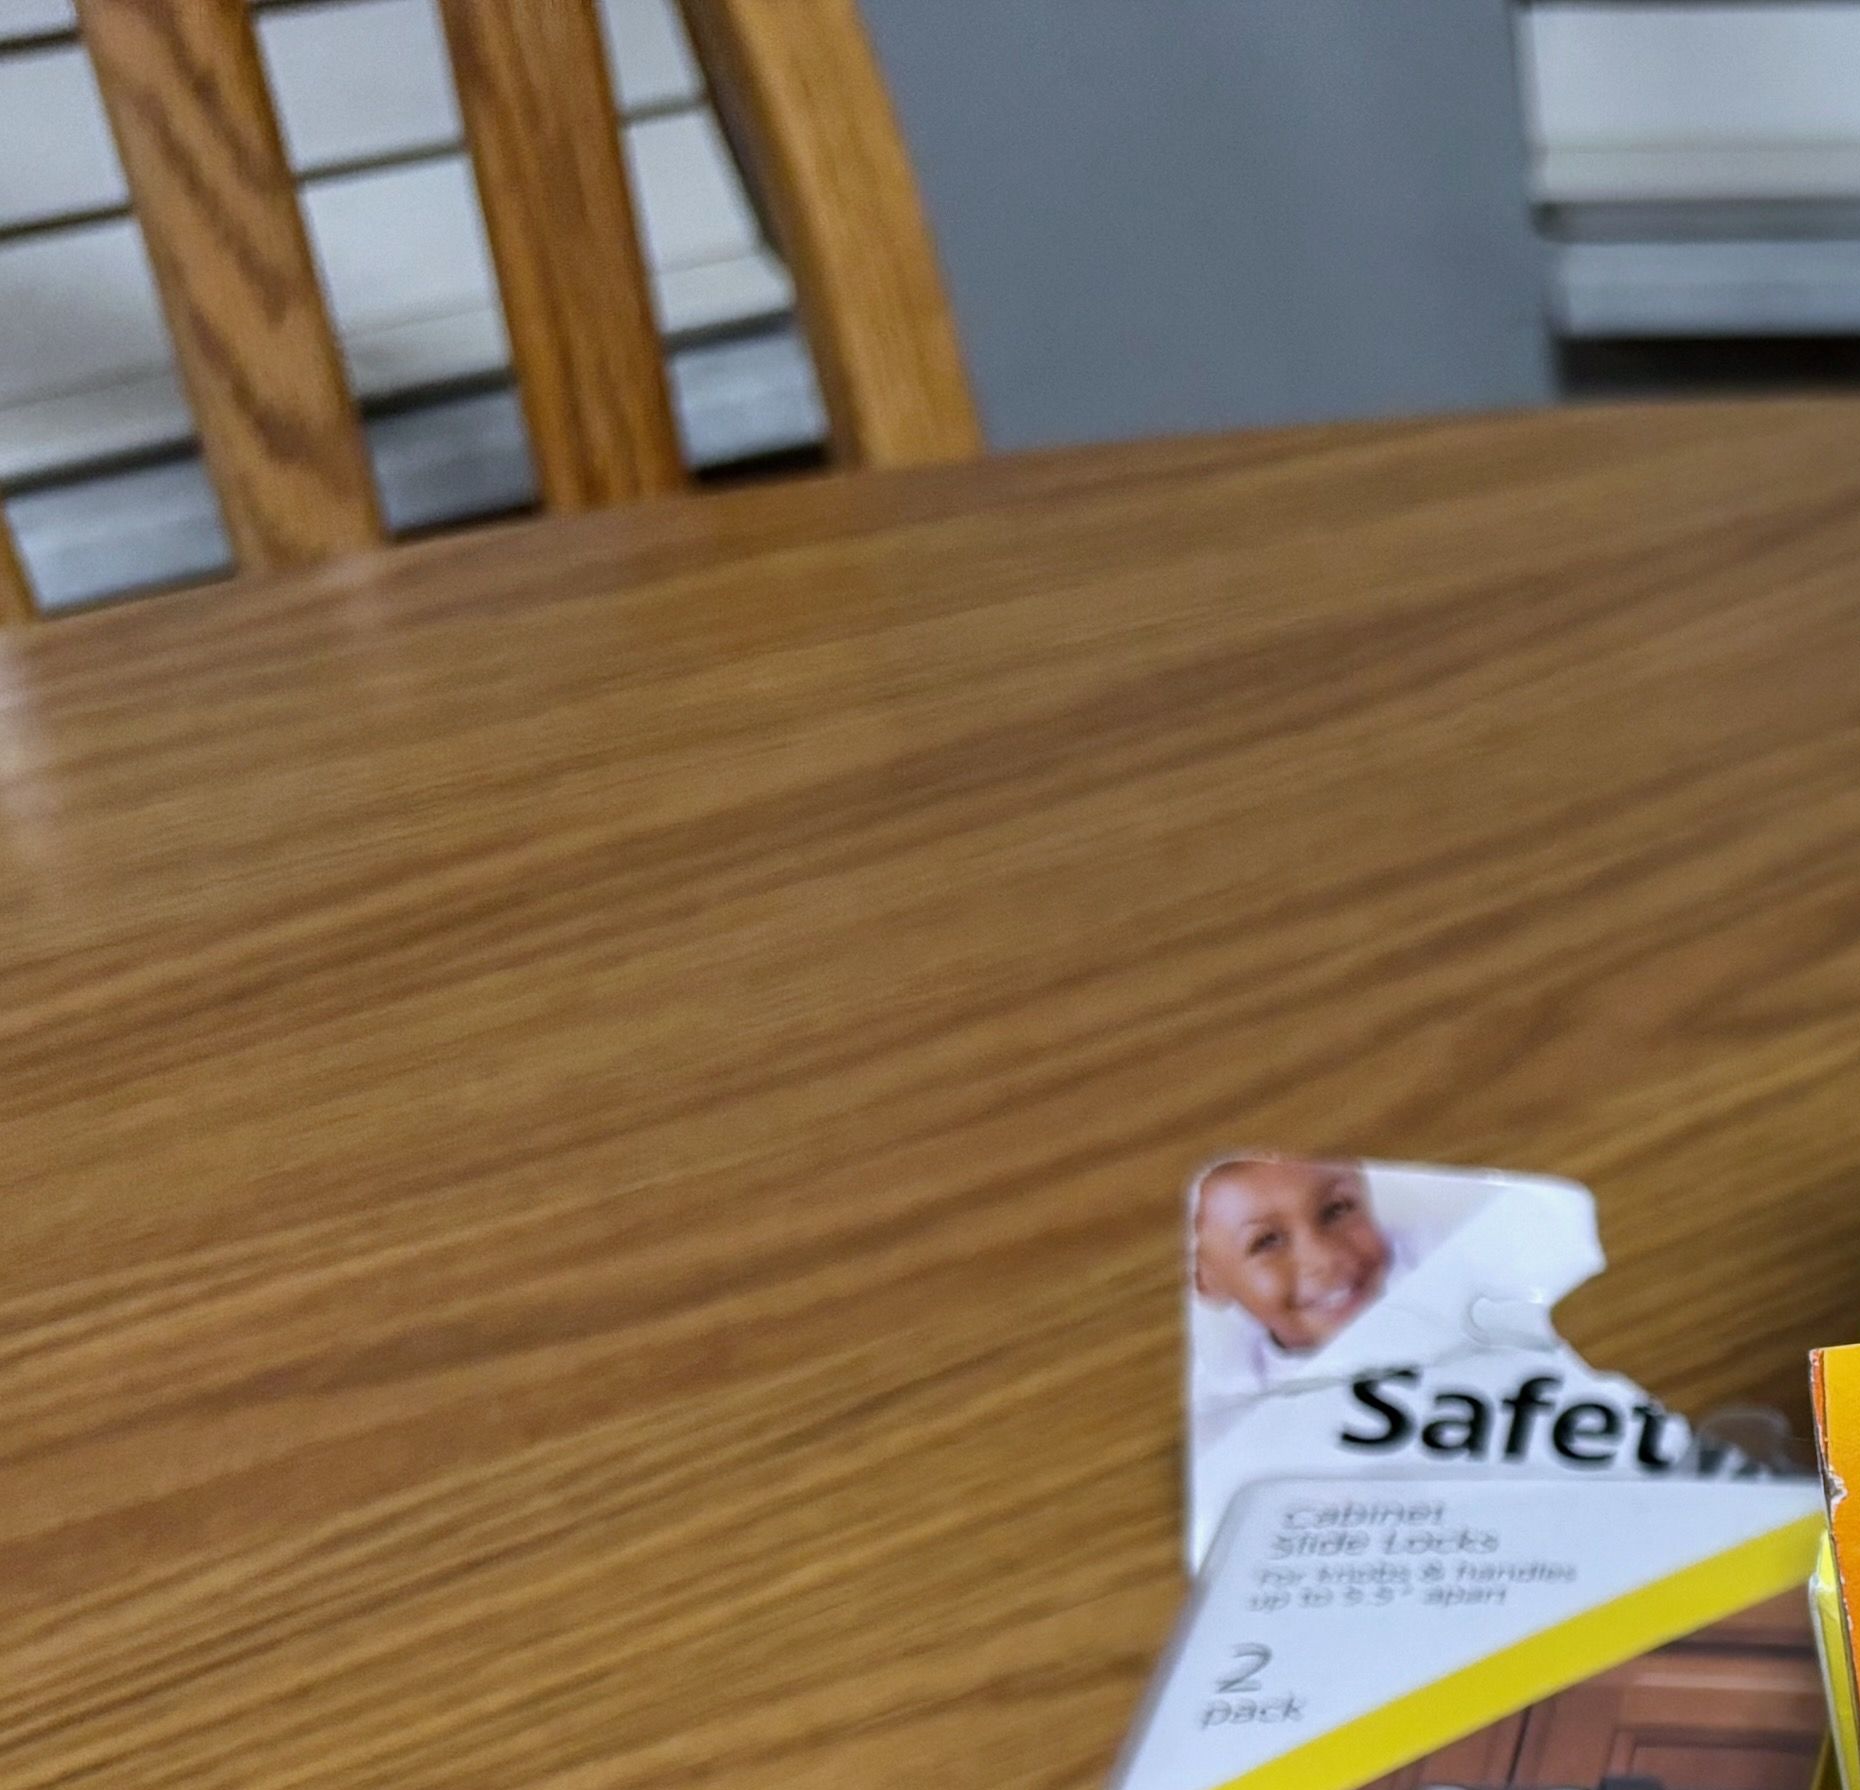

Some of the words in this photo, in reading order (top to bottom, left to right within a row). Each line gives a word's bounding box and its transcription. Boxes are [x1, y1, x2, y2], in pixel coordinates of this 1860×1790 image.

[1340, 1367, 1674, 1476] Safet
[1214, 1642, 1274, 1694] 2
[1199, 1697, 1305, 1731] pack
